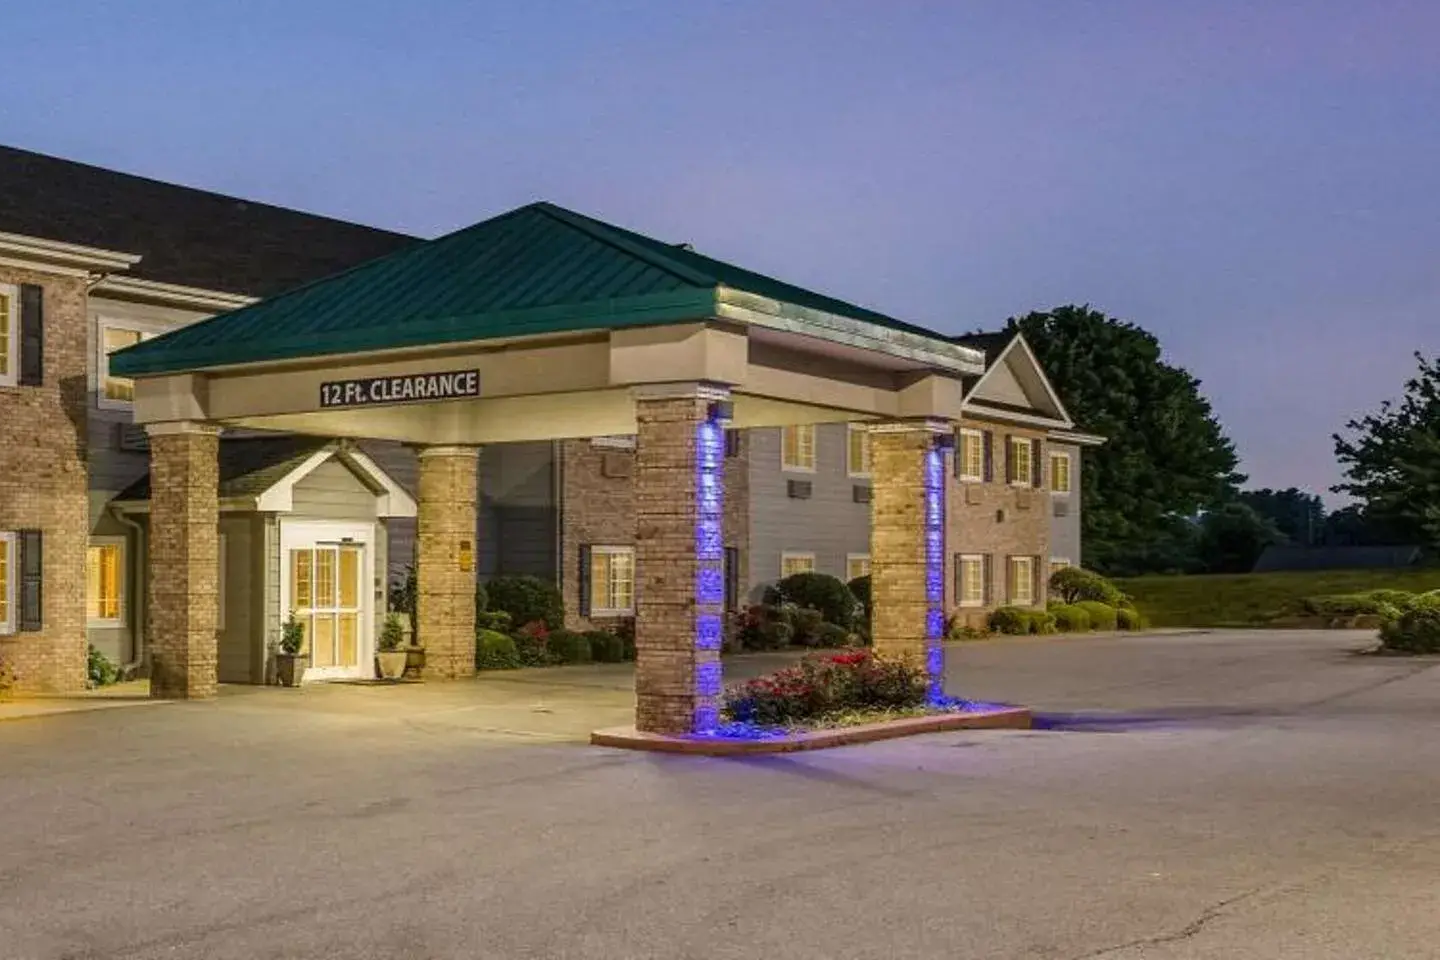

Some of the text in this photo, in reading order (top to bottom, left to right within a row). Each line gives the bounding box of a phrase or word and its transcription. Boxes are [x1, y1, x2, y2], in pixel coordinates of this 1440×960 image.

[322, 372, 477, 404] 12 Ft. CLEARANCE
